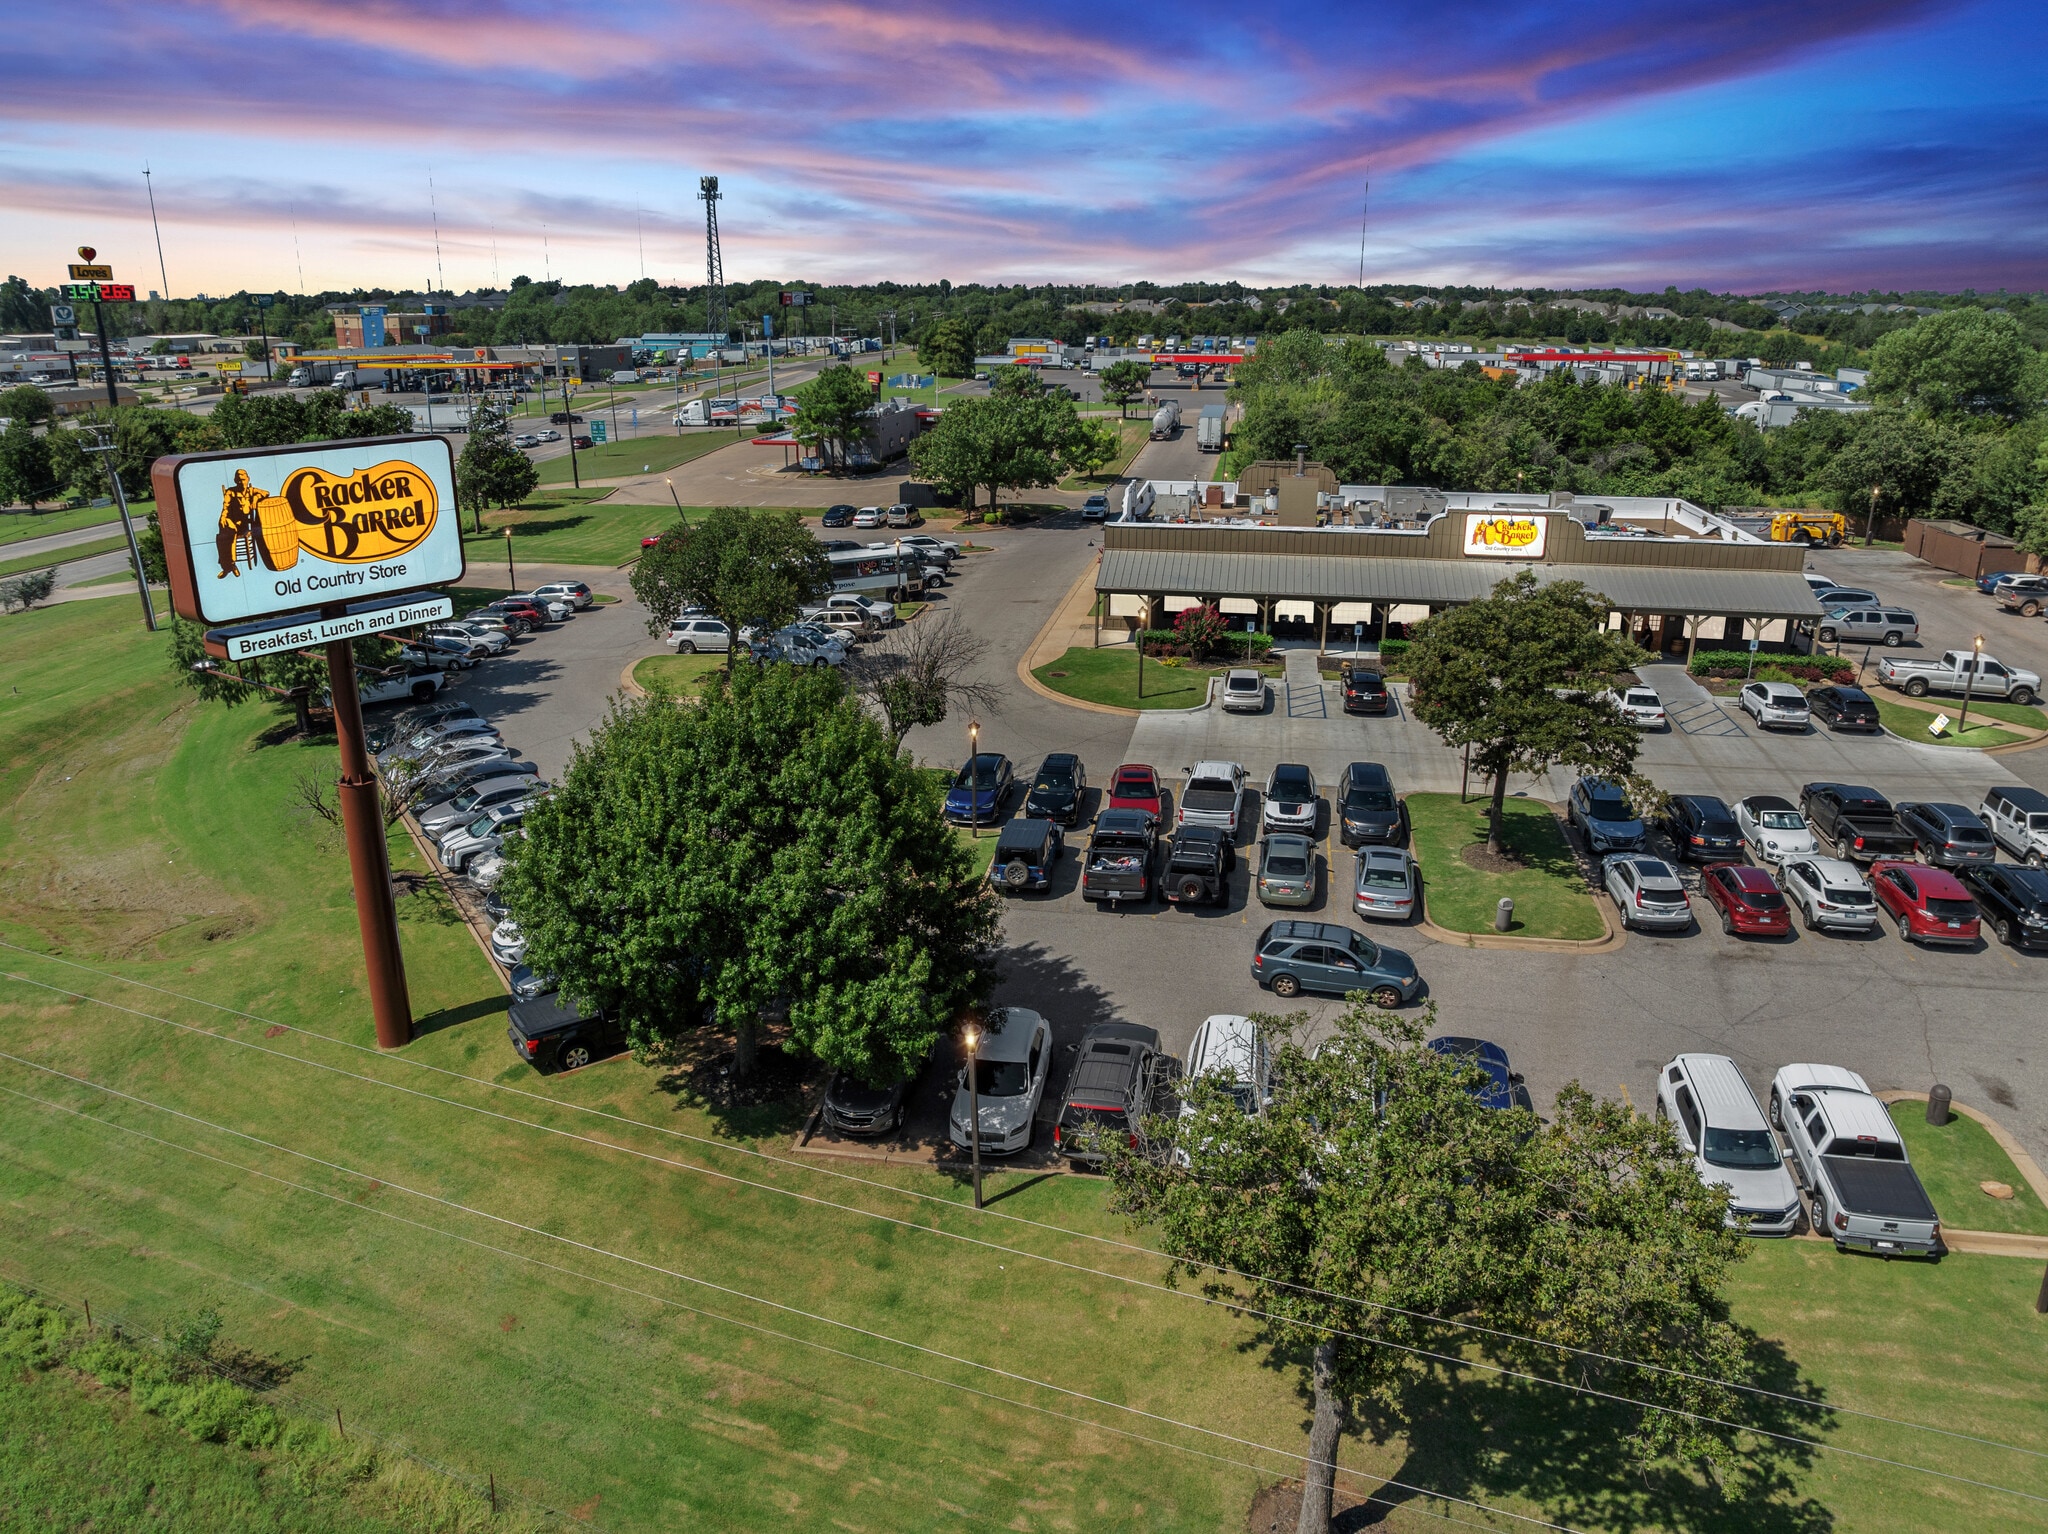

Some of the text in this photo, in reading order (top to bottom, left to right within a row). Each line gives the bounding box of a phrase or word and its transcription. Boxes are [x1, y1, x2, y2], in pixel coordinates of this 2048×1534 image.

[77, 267, 108, 278] Love's
[285, 471, 413, 525] Cracker
[322, 500, 427, 558] Barrel
[1494, 520, 1532, 534] Cracker
[1501, 530, 1534, 544] Barrel
[275, 563, 408, 597] Old Country Store
[240, 604, 443, 655] Breakfast, Lunch and Dinner
